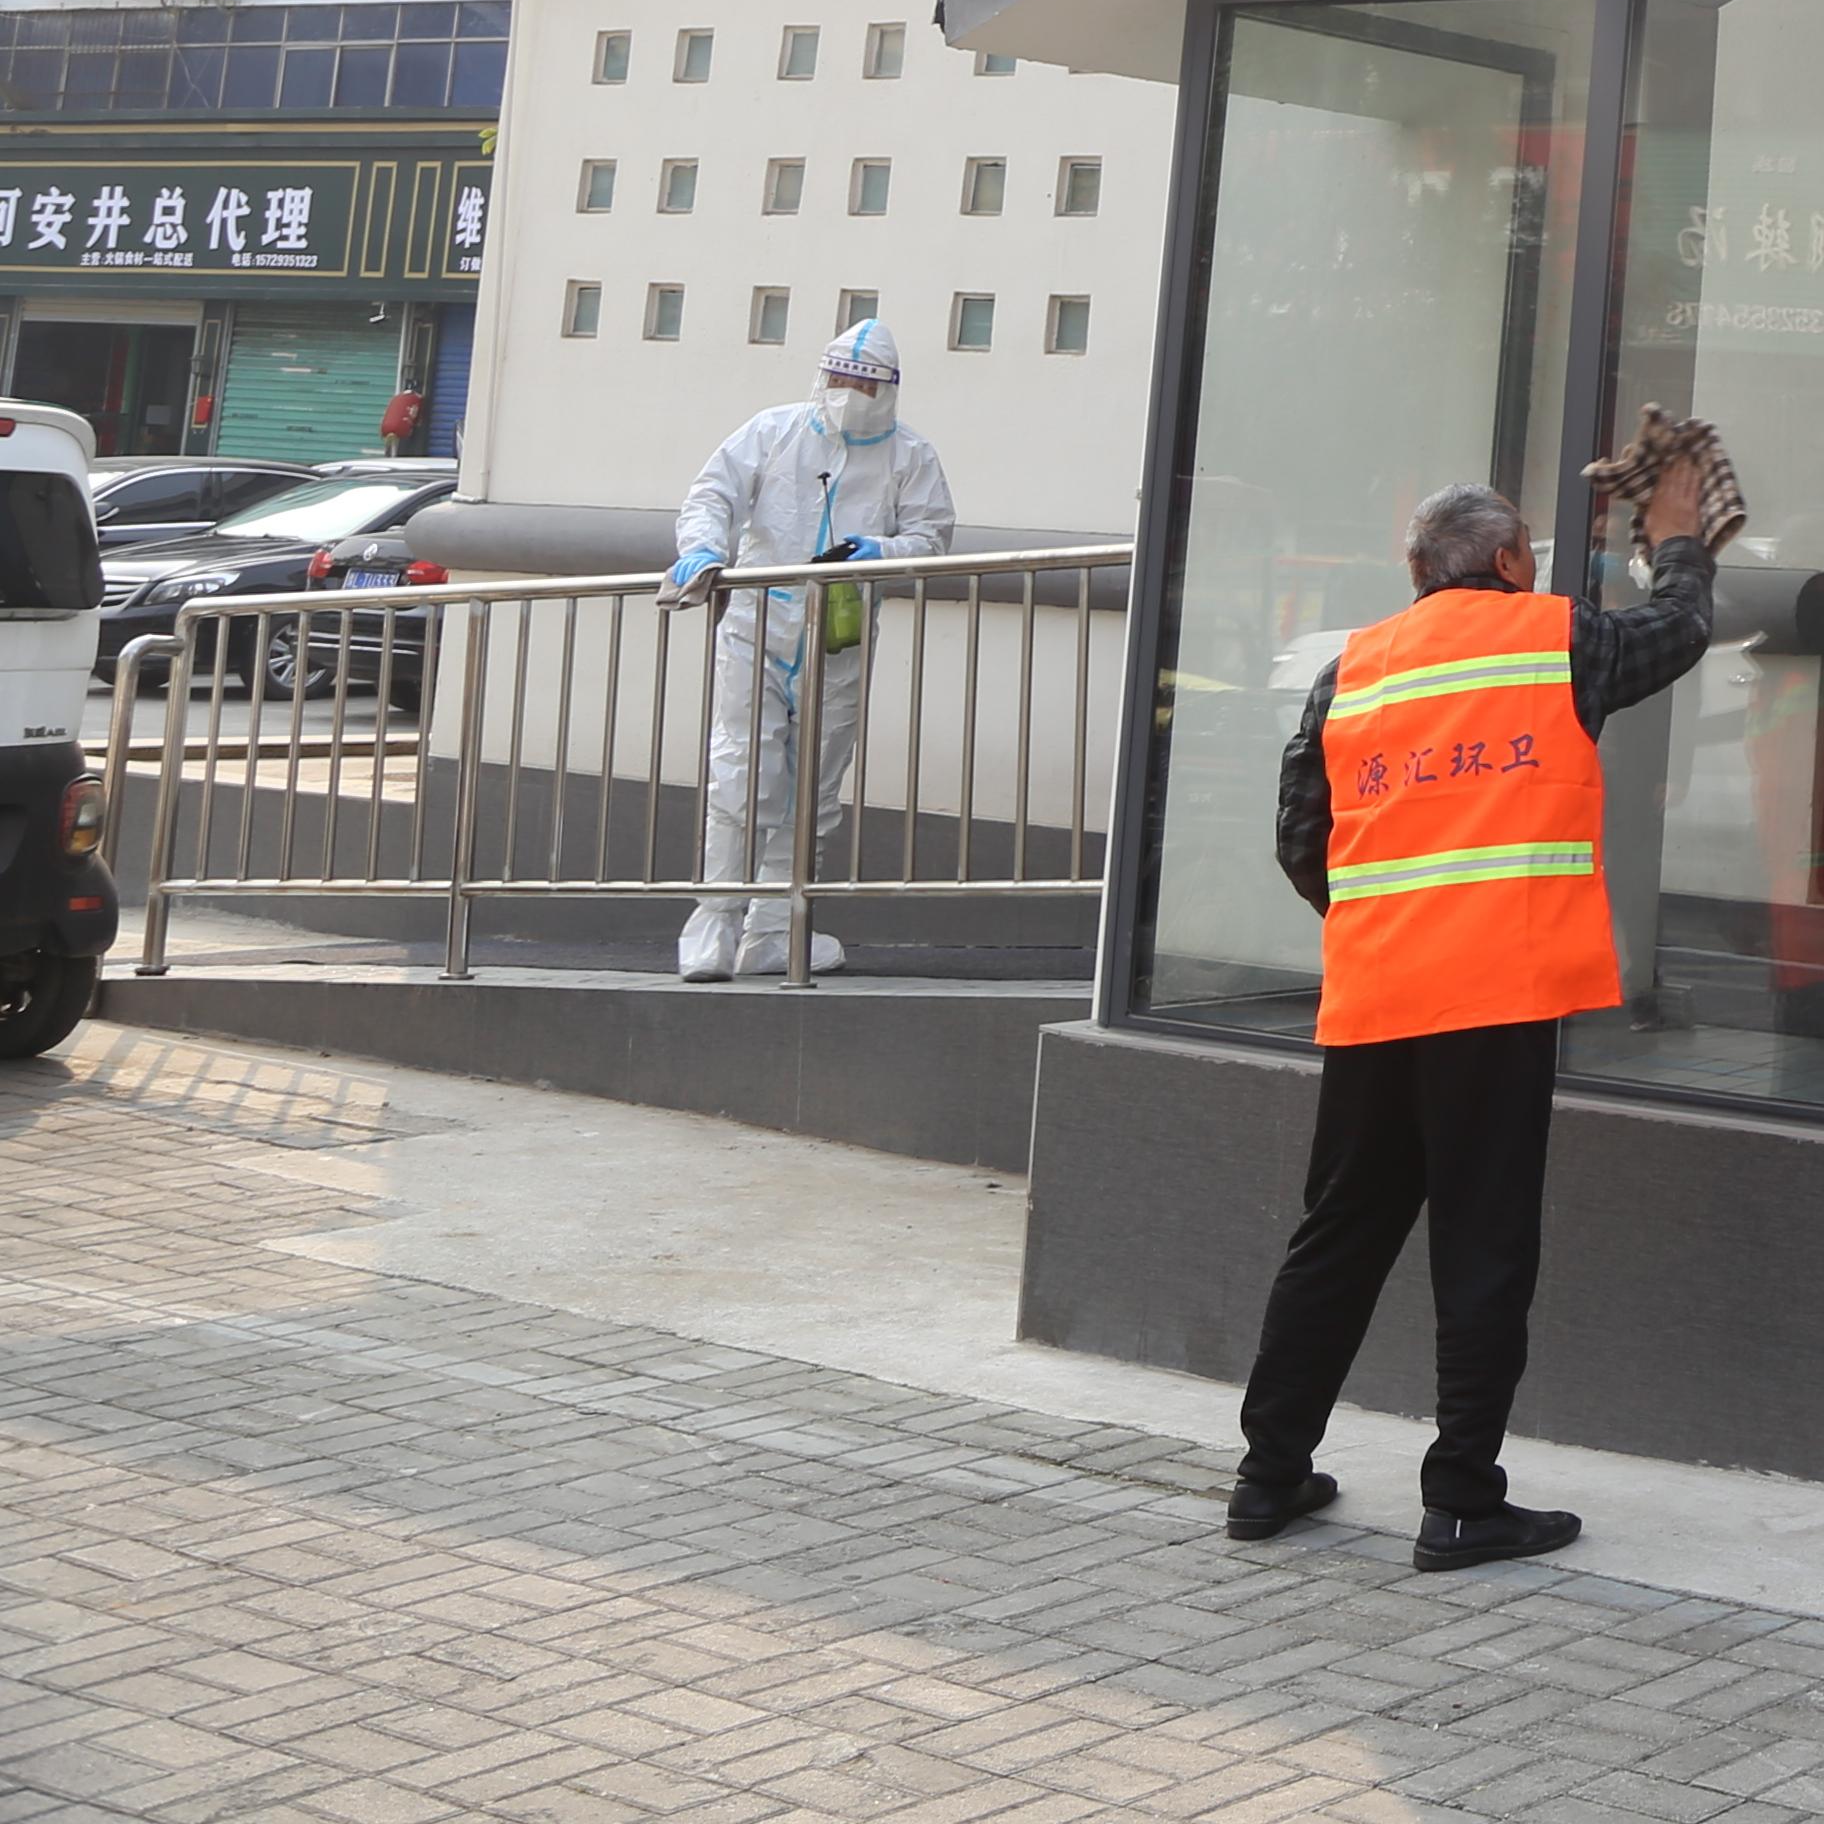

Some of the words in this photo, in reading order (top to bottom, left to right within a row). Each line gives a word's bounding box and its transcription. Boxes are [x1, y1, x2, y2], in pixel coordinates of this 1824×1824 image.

[455, 186, 485, 249] 维
[1357, 733, 1540, 801] 源汇环卫
